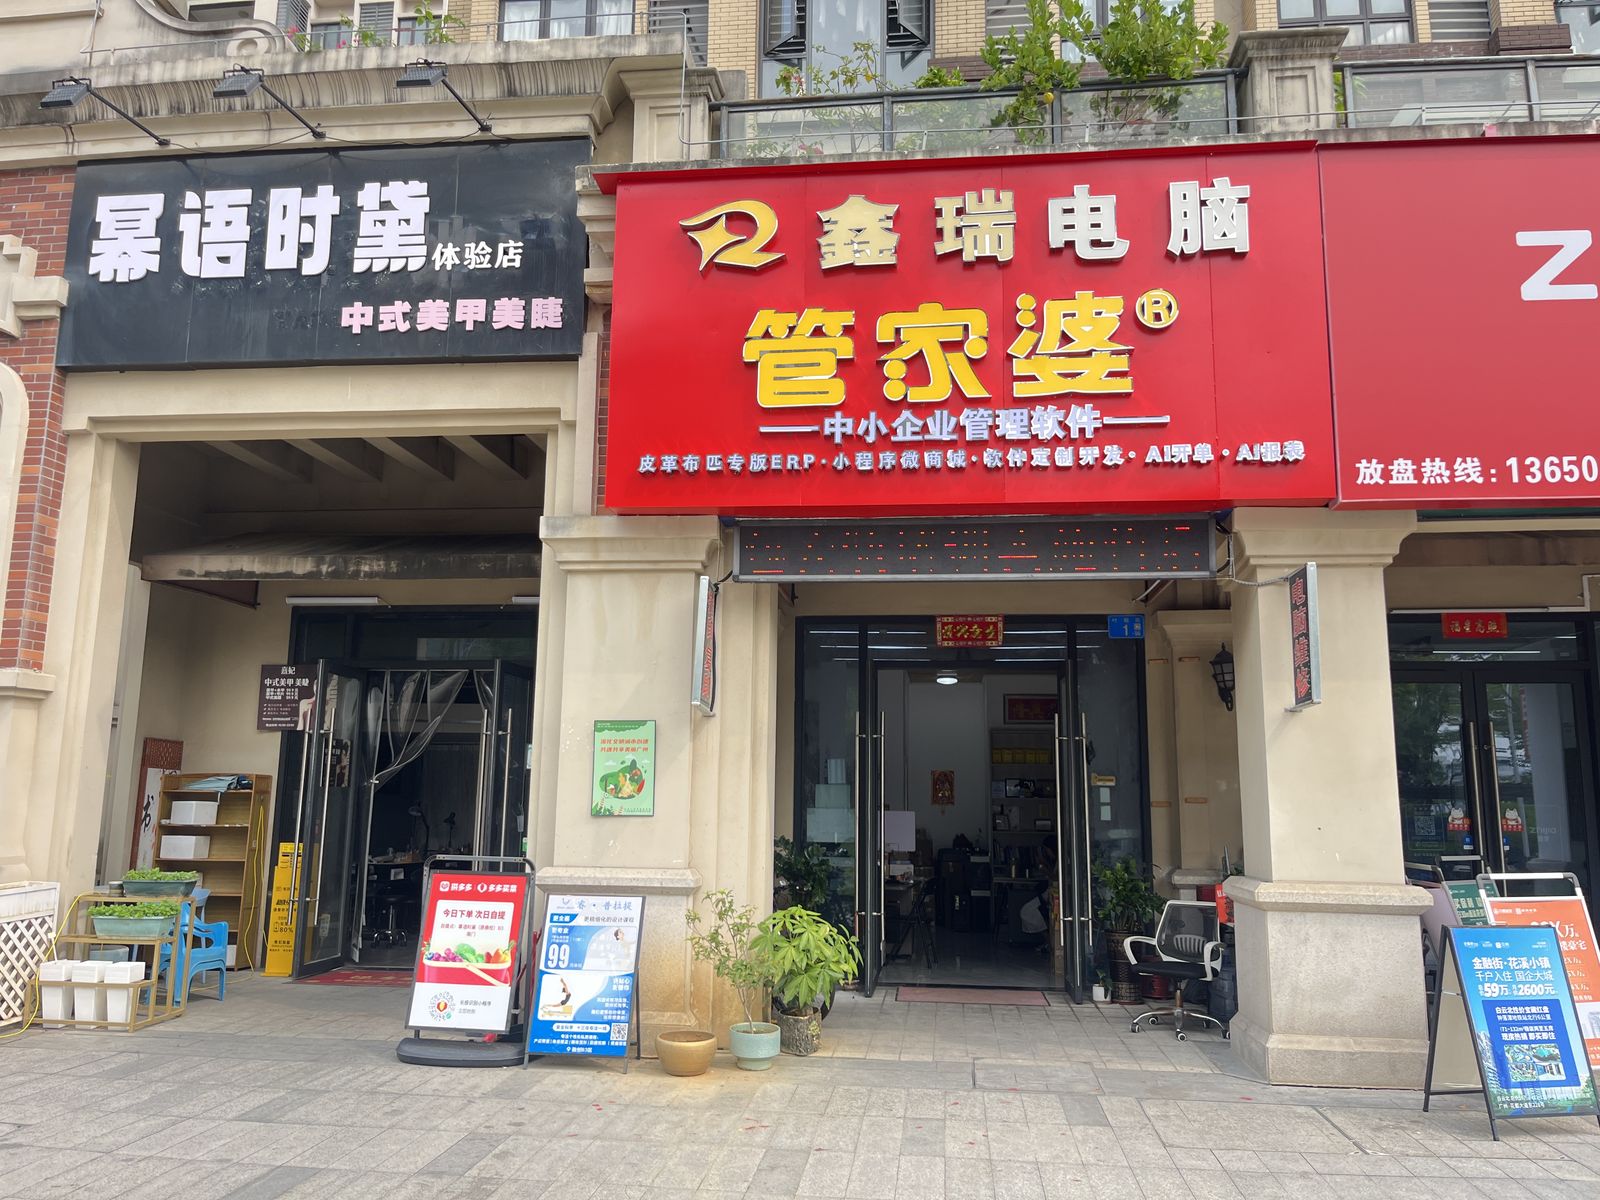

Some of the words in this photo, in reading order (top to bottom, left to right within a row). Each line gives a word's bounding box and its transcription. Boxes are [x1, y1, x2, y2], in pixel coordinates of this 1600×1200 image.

[816, 176, 1252, 271] 鑫瑞电脑
[431, 240, 525, 271] 体验店
[340, 296, 564, 334] 中式美甲美睫
[741, 290, 1134, 409] 管家婆
[822, 404, 1103, 445] 中小企业管理软件
[443, 908, 474, 919] 今日下单
[475, 909, 506, 920] 次日自提
[547, 943, 570, 969] 99
